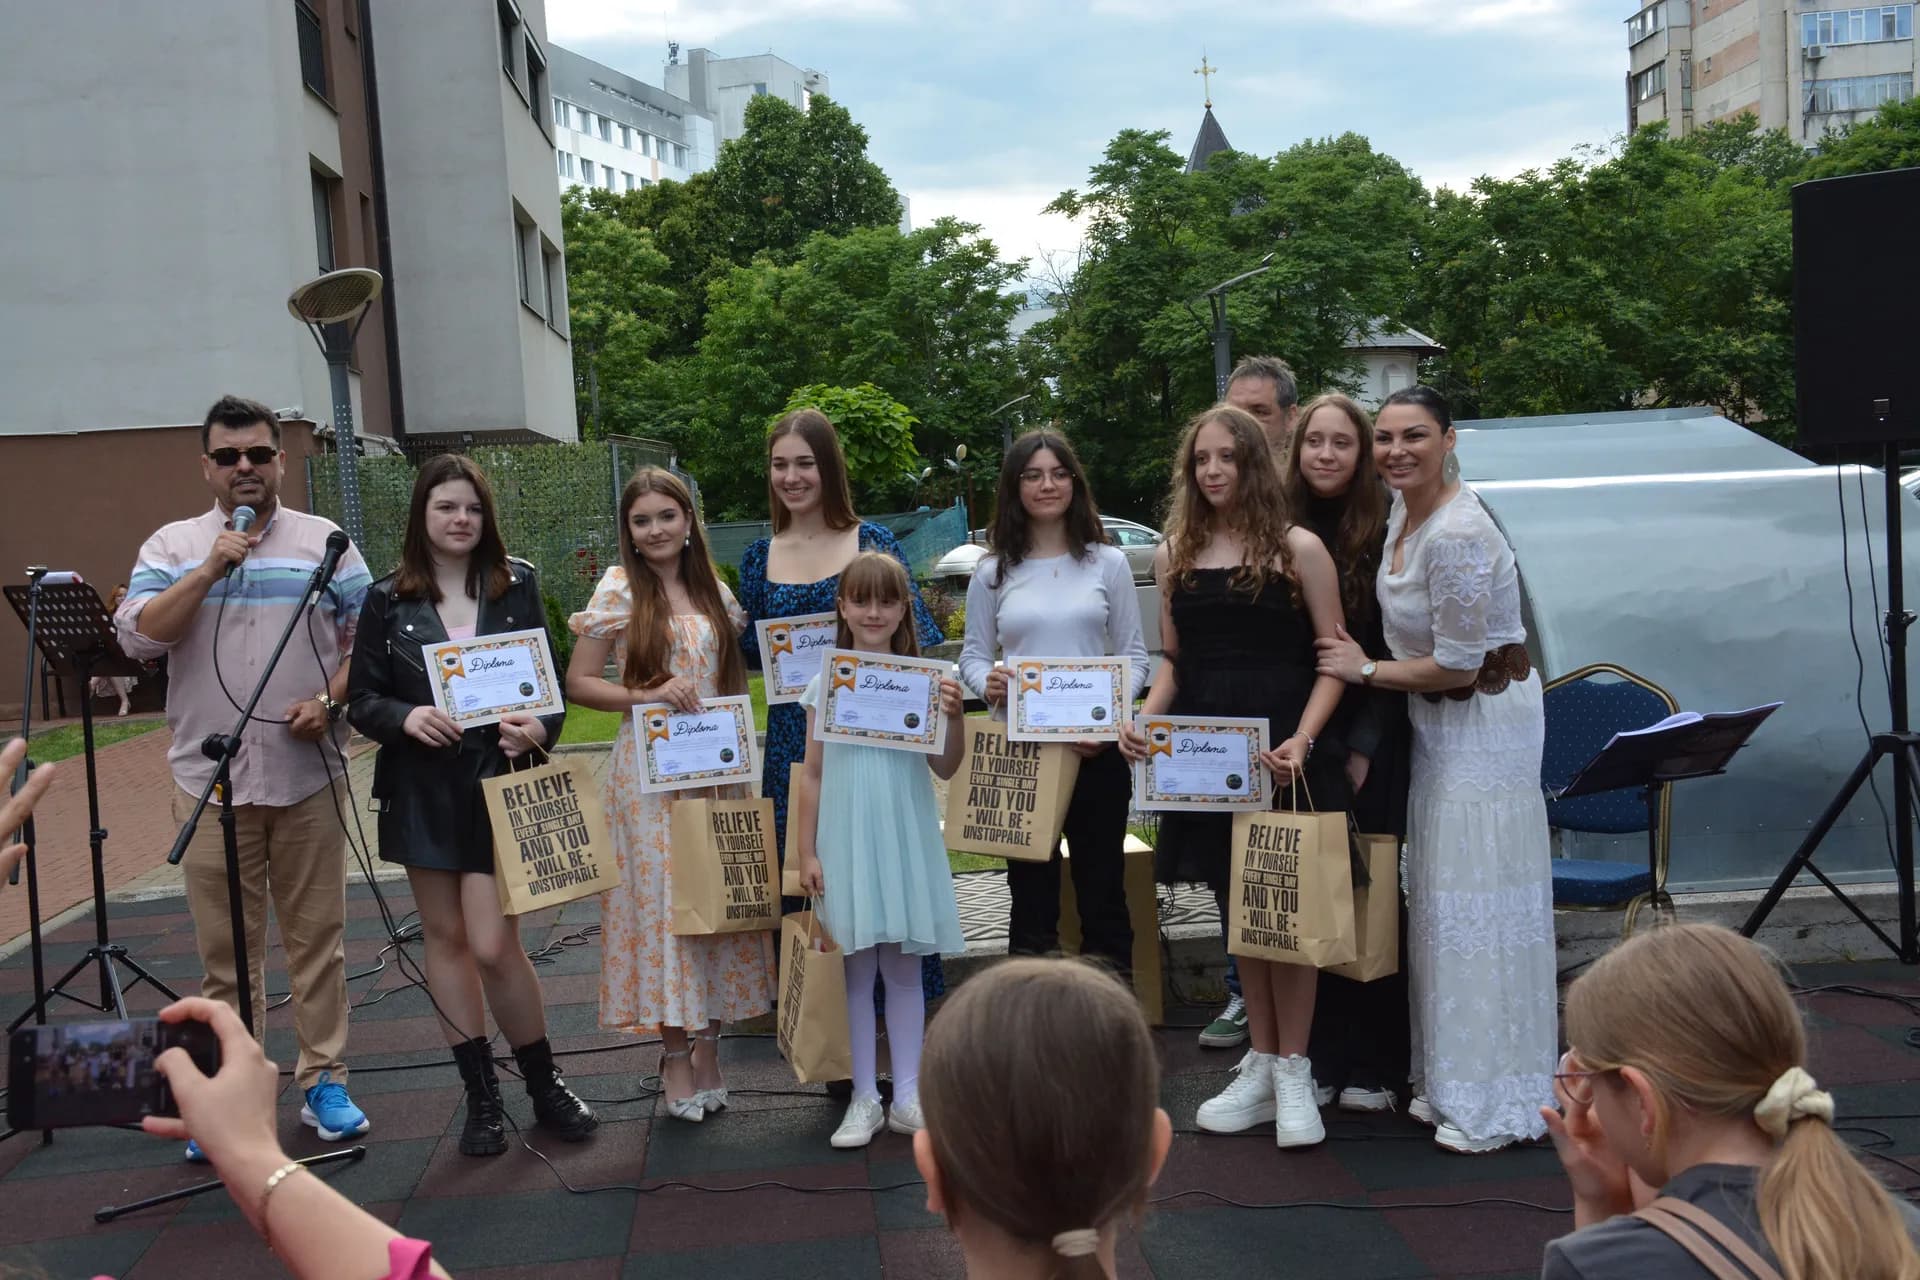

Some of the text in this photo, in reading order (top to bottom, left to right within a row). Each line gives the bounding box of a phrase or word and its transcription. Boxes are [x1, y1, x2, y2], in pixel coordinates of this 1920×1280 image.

[796, 635, 836, 649] Diplom
[468, 657, 515, 673] Diploma
[859, 674, 910, 693] Diploma
[1046, 676, 1094, 692] Diploma
[673, 721, 719, 737] Diploma
[973, 732, 1042, 760] BELIEVE
[1176, 738, 1229, 756] Diploma
[972, 755, 1040, 777] IN YOURSELF
[502, 771, 575, 810] BELIEVE
[967, 786, 1036, 813] AND YOU
[508, 794, 579, 828] IN YOURSELF
[976, 808, 1024, 829] WILL BE
[712, 811, 762, 834] BELIEVE
[520, 825, 590, 863] AND YOU
[715, 833, 764, 851] IN YOURSELF
[963, 825, 1032, 846] UNSTOPPABLE
[1248, 824, 1301, 854] BELIEVE
[533, 849, 585, 877] WILL BE
[1245, 849, 1299, 874] IN YOURSELF
[528, 864, 600, 896] UNSTOPPABLE
[724, 864, 768, 886] AND YOU
[732, 886, 764, 903] WILL BE
[1242, 884, 1299, 914] AND YOU
[726, 903, 771, 920] UNSTOPPABLE
[1250, 909, 1289, 933] WILL BE
[1241, 928, 1299, 952] UNSTOPPABLE
